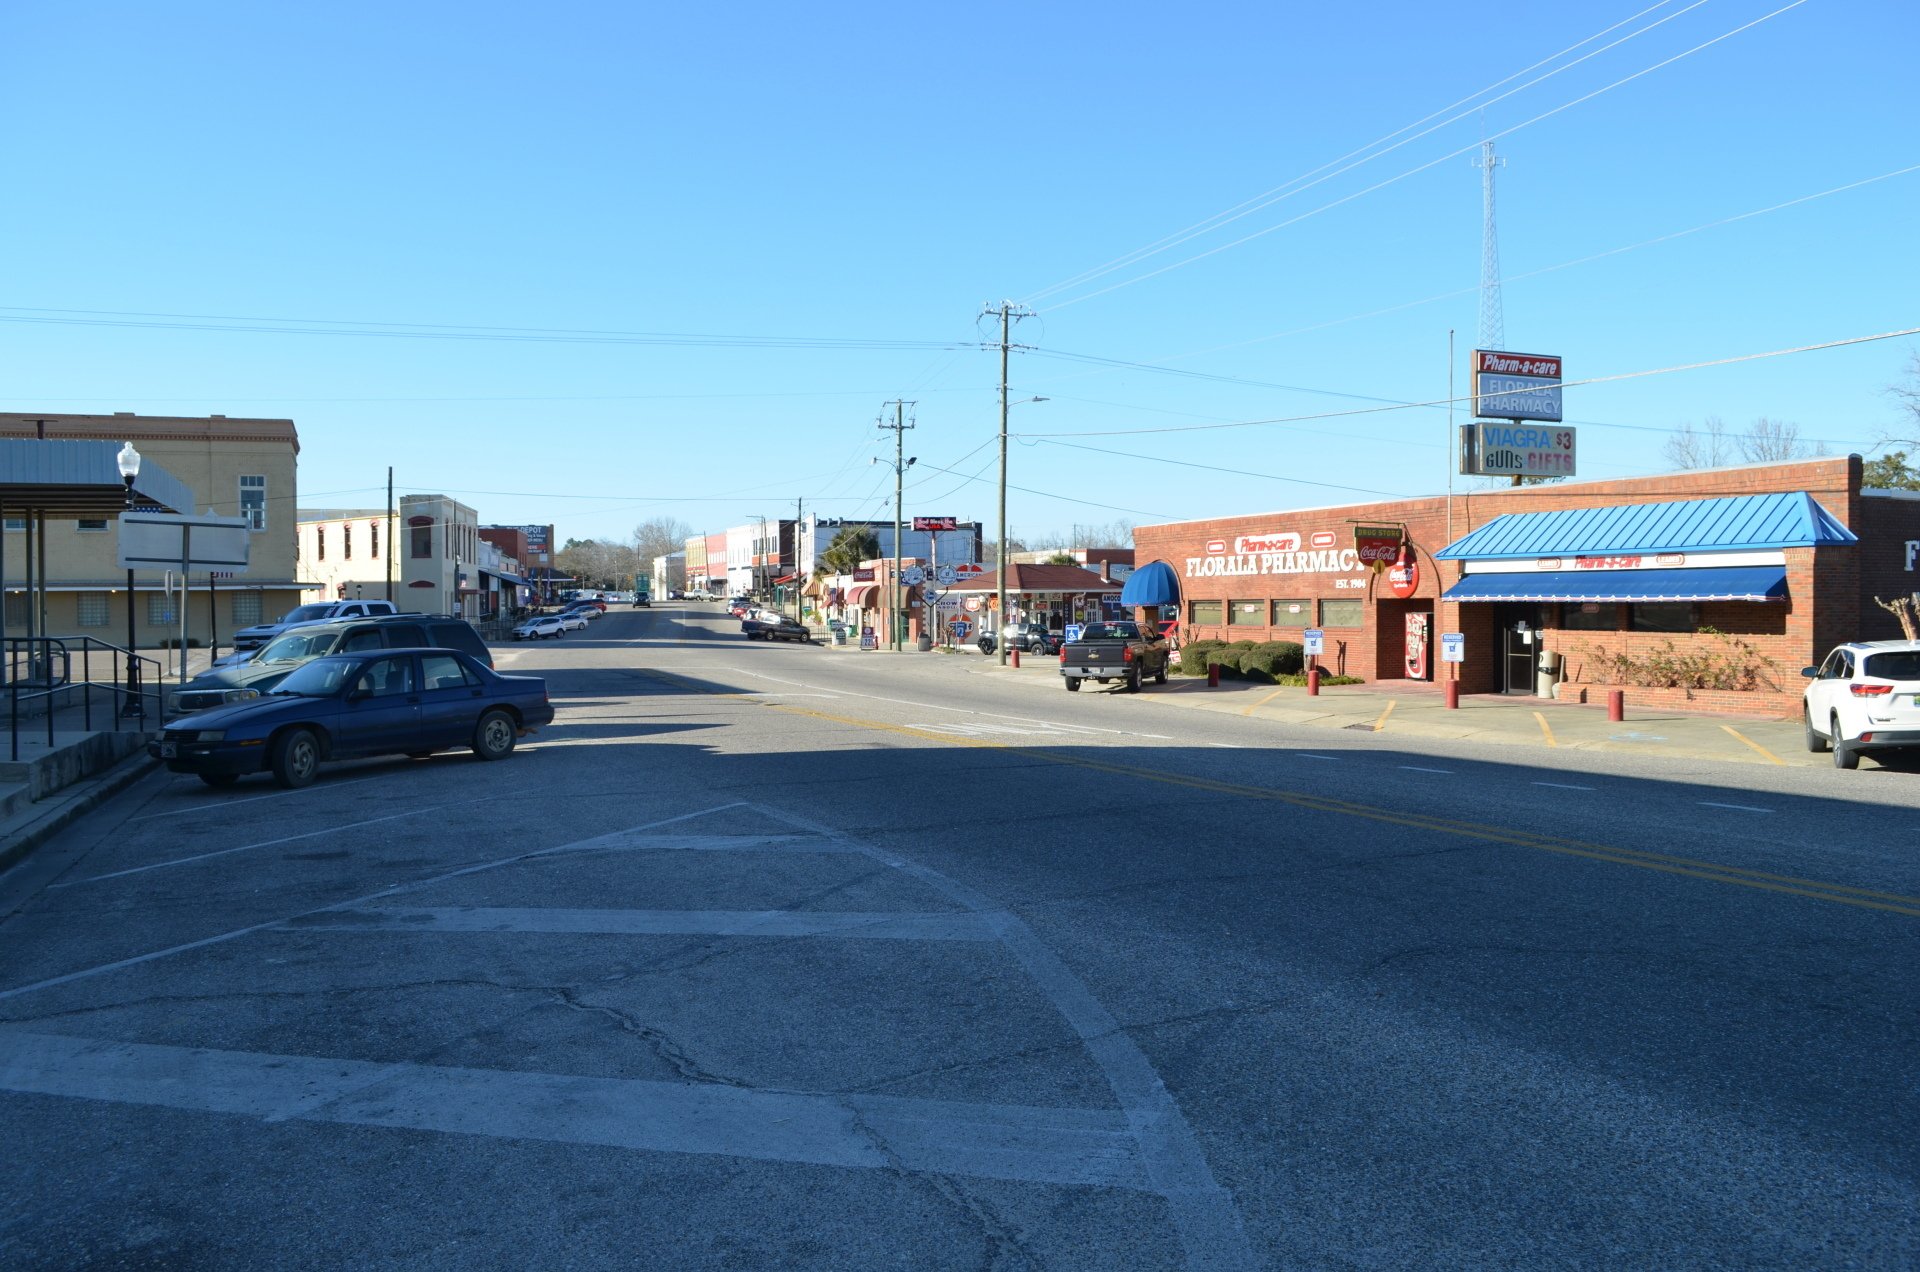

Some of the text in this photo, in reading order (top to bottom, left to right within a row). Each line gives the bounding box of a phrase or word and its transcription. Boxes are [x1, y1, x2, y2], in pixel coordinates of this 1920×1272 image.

[1489, 379, 1553, 397] FLORALA
[1480, 397, 1561, 414] PHARMACY
[1484, 428, 1572, 450] VIAGRA $3
[1528, 452, 1572, 471] GIFTS
[1186, 555, 1259, 577] FLORALA
